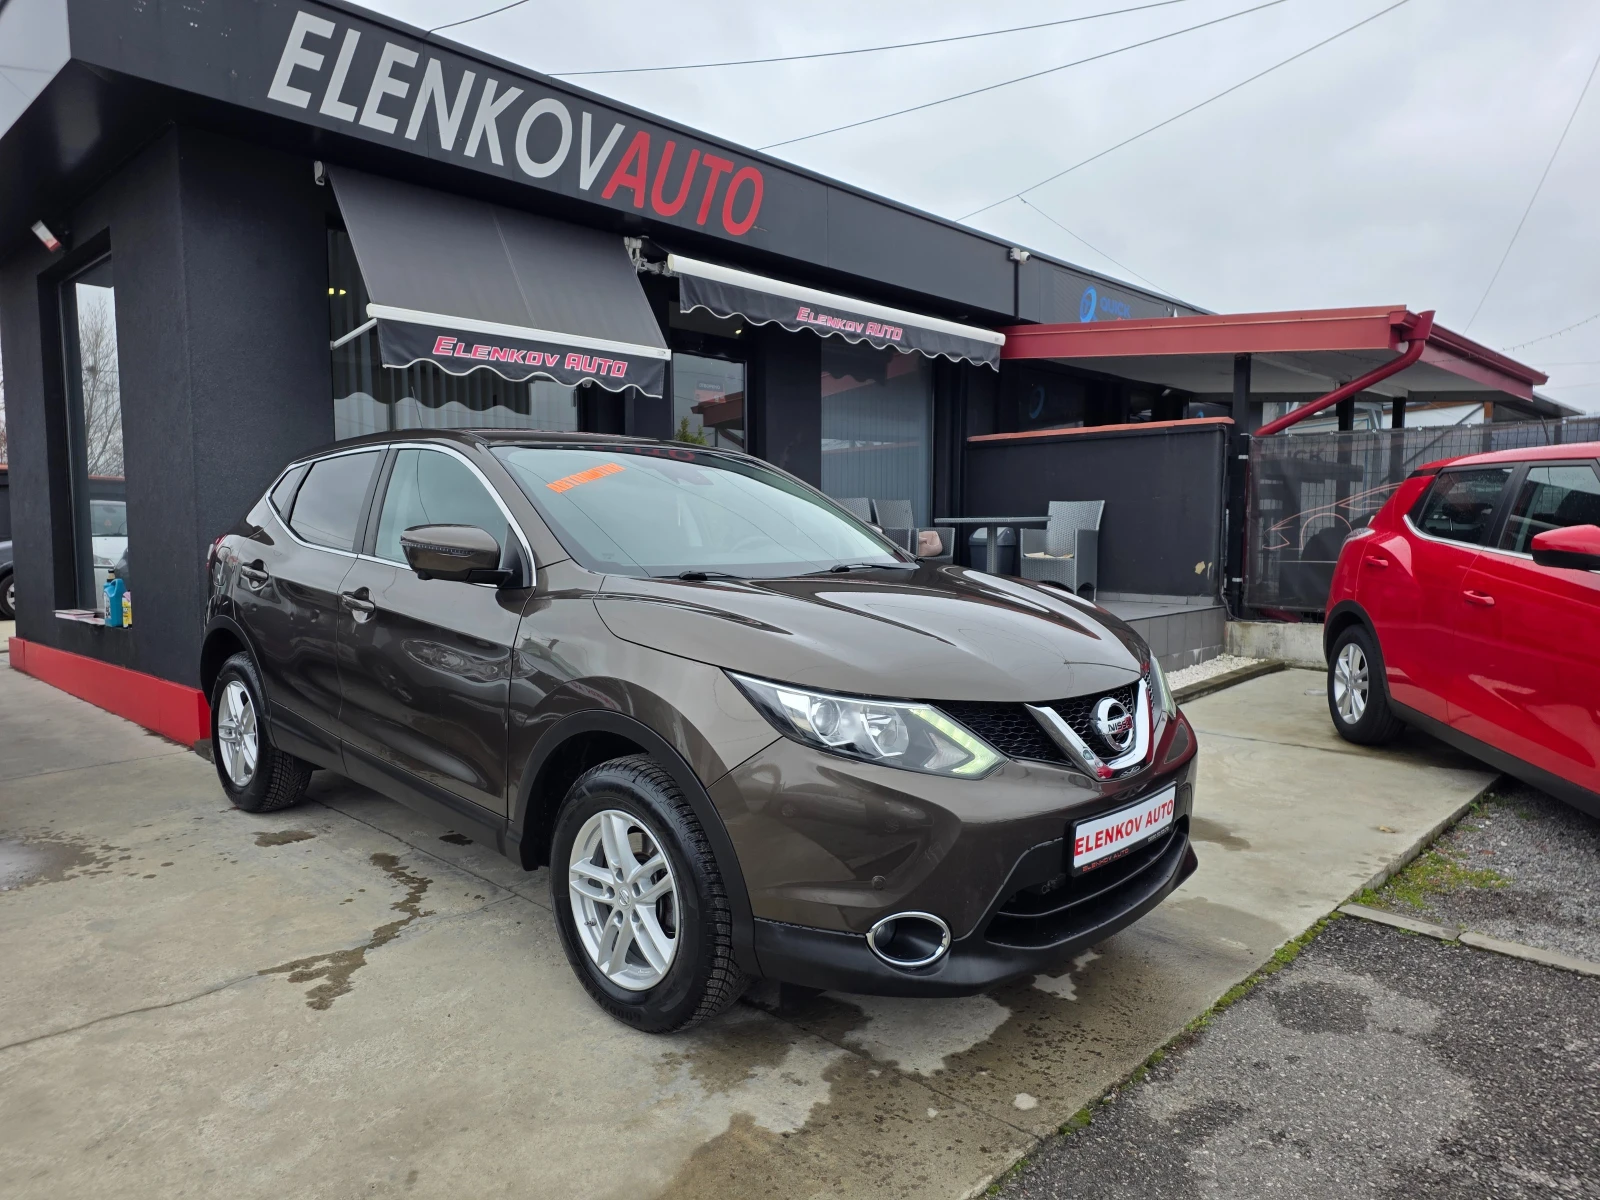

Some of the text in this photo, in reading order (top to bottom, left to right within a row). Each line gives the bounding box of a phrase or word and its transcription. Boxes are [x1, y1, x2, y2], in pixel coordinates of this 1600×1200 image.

[796, 307, 904, 341] ELENKOV AUTO
[1100, 297, 1131, 318] QUICK
[432, 335, 628, 378] ELENKOV AUTO
[1073, 814, 1143, 857] ELENKOV
[1145, 799, 1174, 829] AUTO
